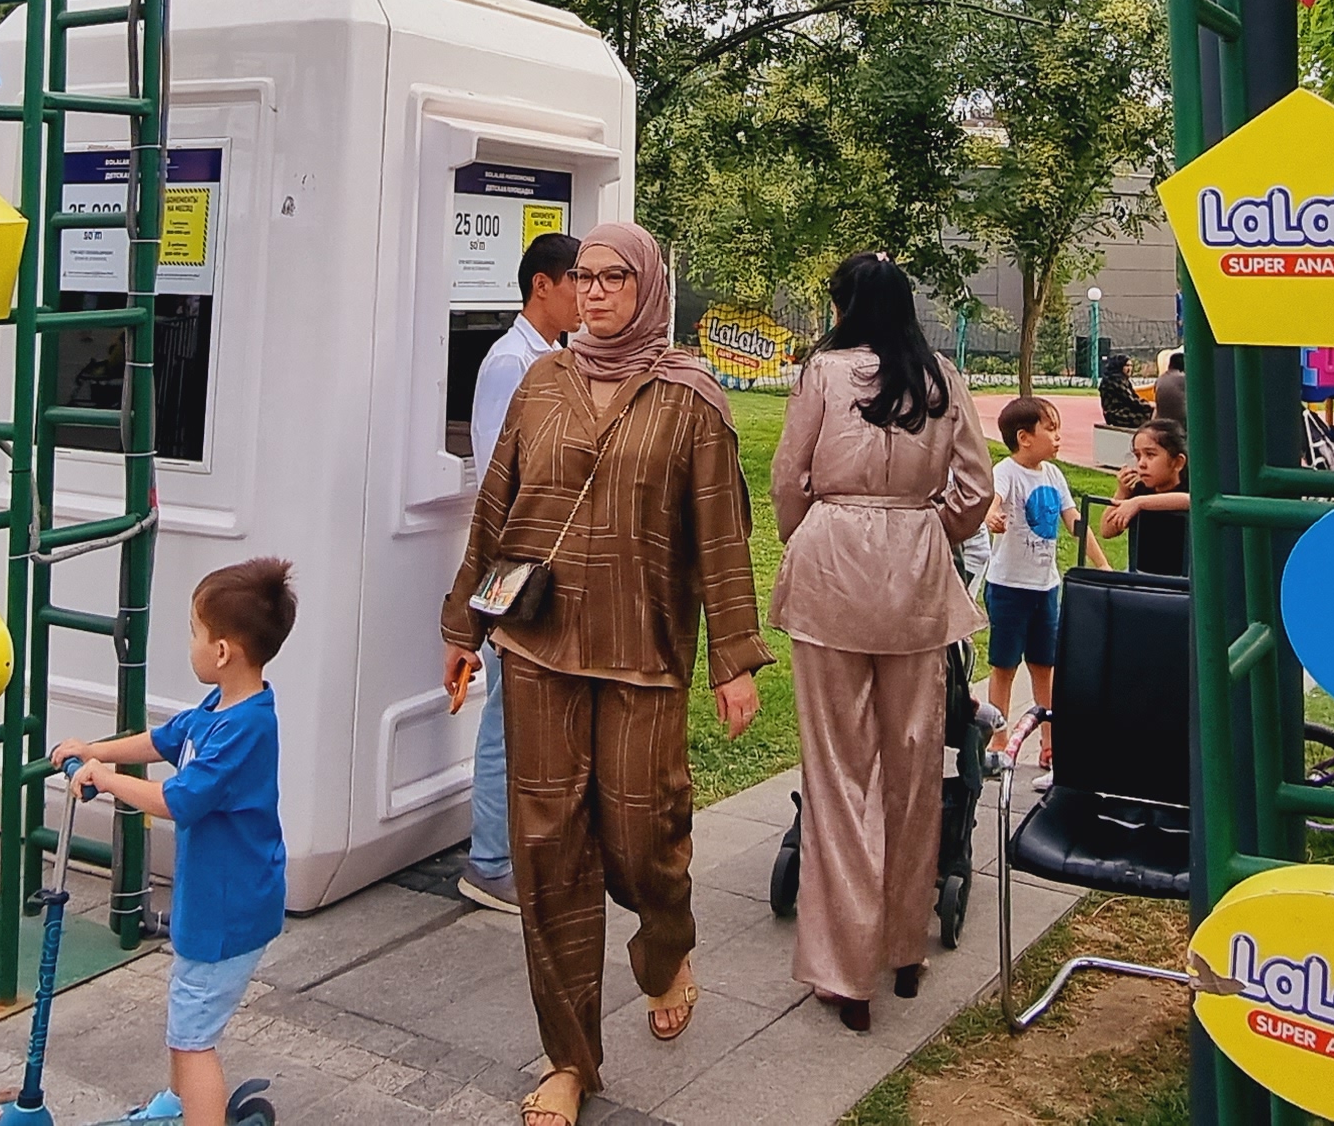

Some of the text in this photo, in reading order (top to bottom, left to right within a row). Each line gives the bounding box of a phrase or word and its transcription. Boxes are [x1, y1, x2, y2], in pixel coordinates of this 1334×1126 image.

[455, 212, 500, 237] 25 000
[1228, 257, 1285, 274] SUPER
[1255, 1014, 1316, 1049] SUPER
